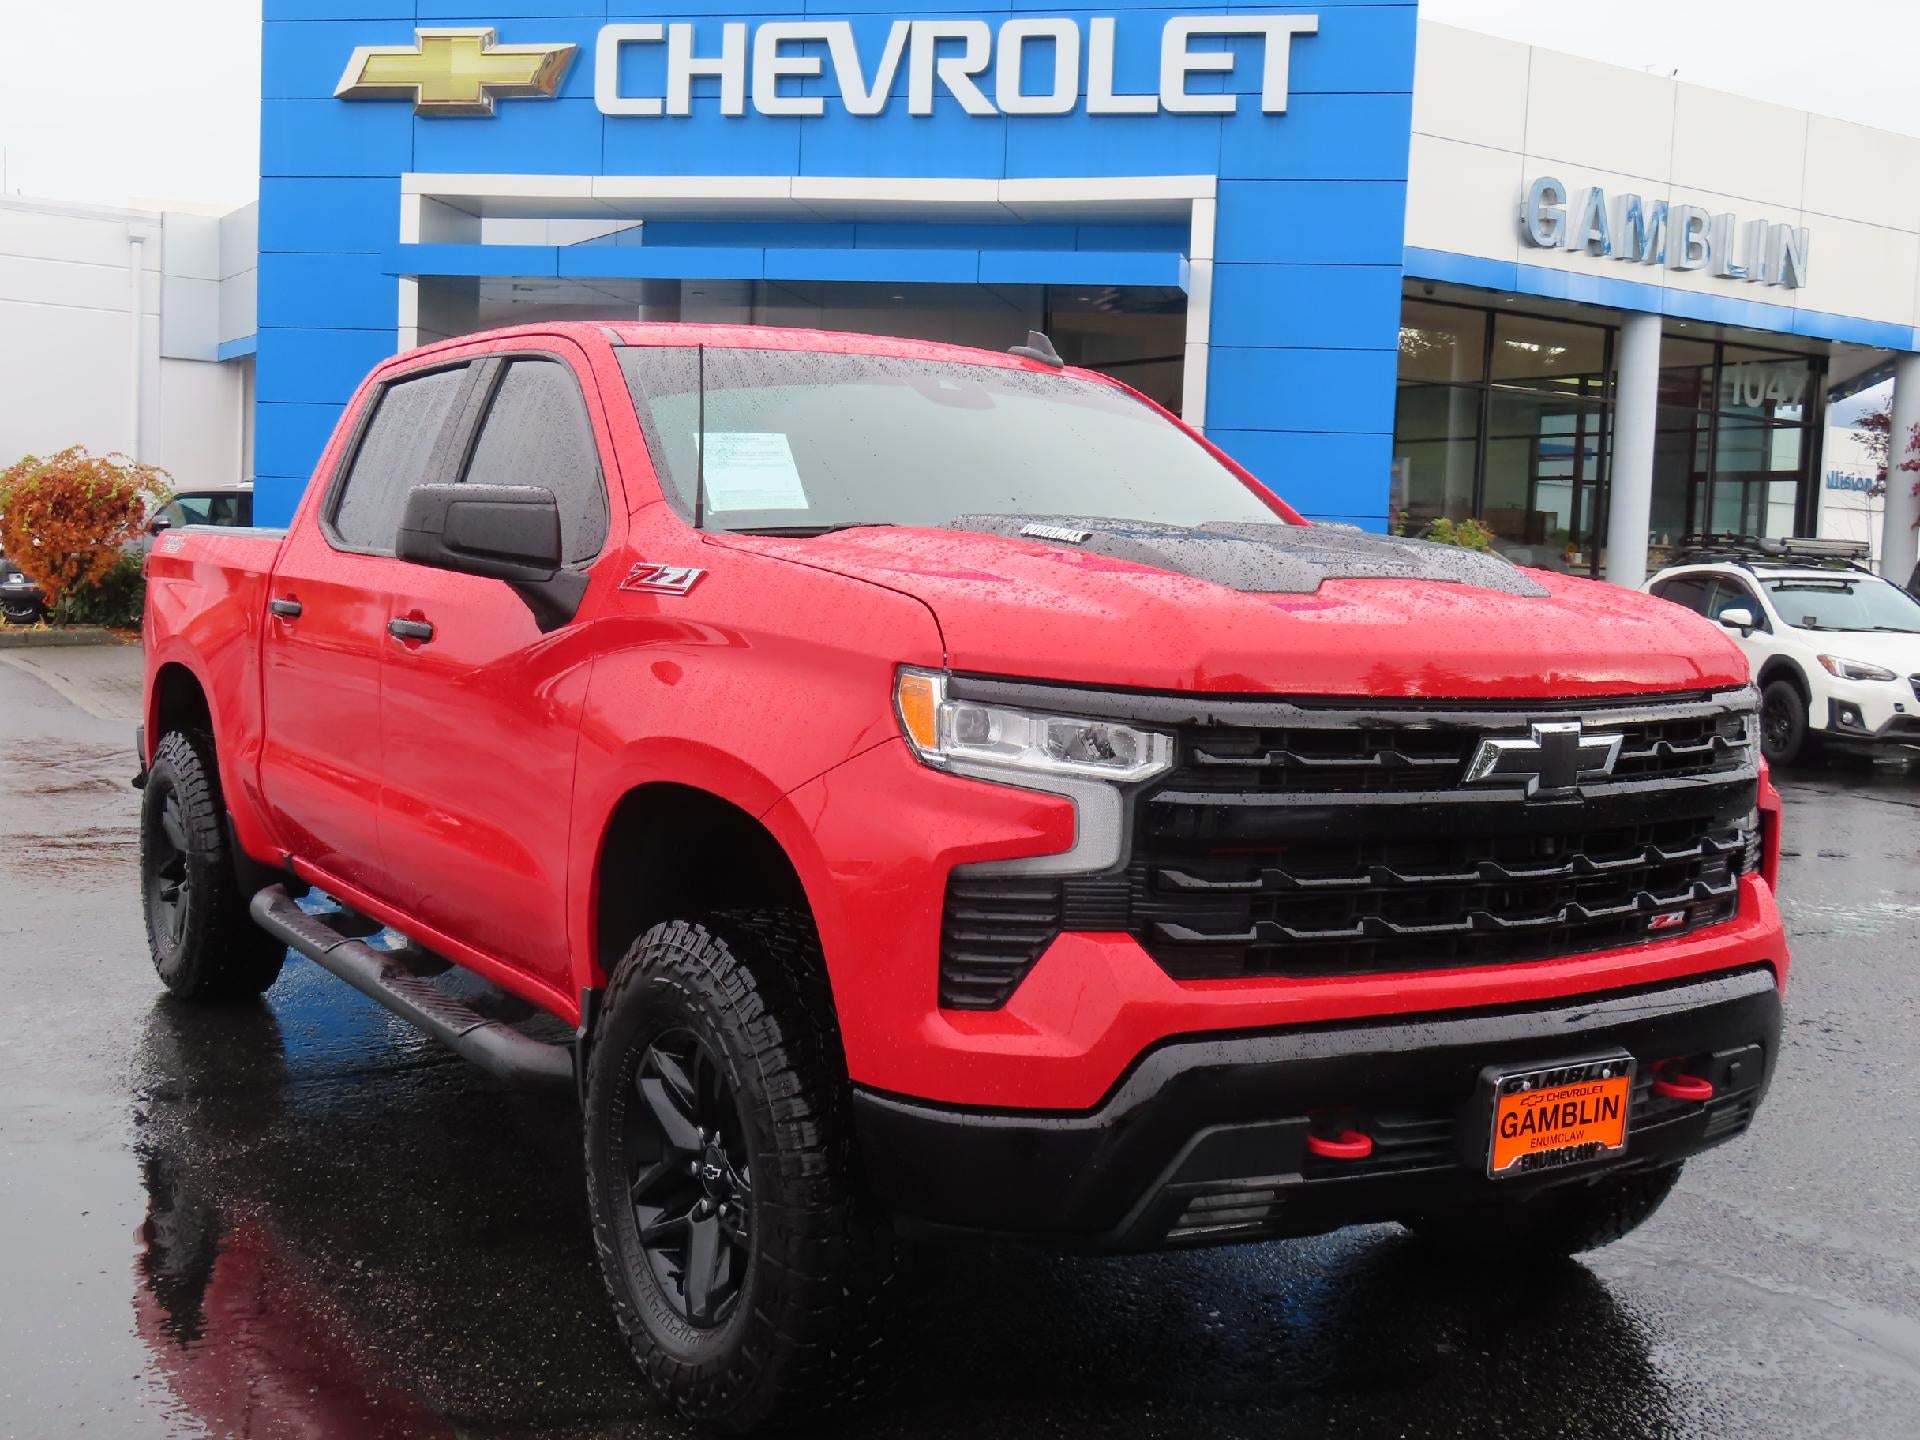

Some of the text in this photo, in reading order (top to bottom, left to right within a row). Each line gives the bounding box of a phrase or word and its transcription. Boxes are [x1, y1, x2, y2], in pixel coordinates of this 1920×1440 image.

[593, 14, 1319, 118] CHEVROLET
[1525, 176, 1809, 289] GAMBLIN
[1732, 360, 1809, 412] 1047
[619, 562, 708, 595] Z71
[1546, 1085, 1604, 1102] CHEVROLET
[1500, 1095, 1620, 1139] GAMBLIN
[1530, 1130, 1585, 1148] ENUMCLAW
